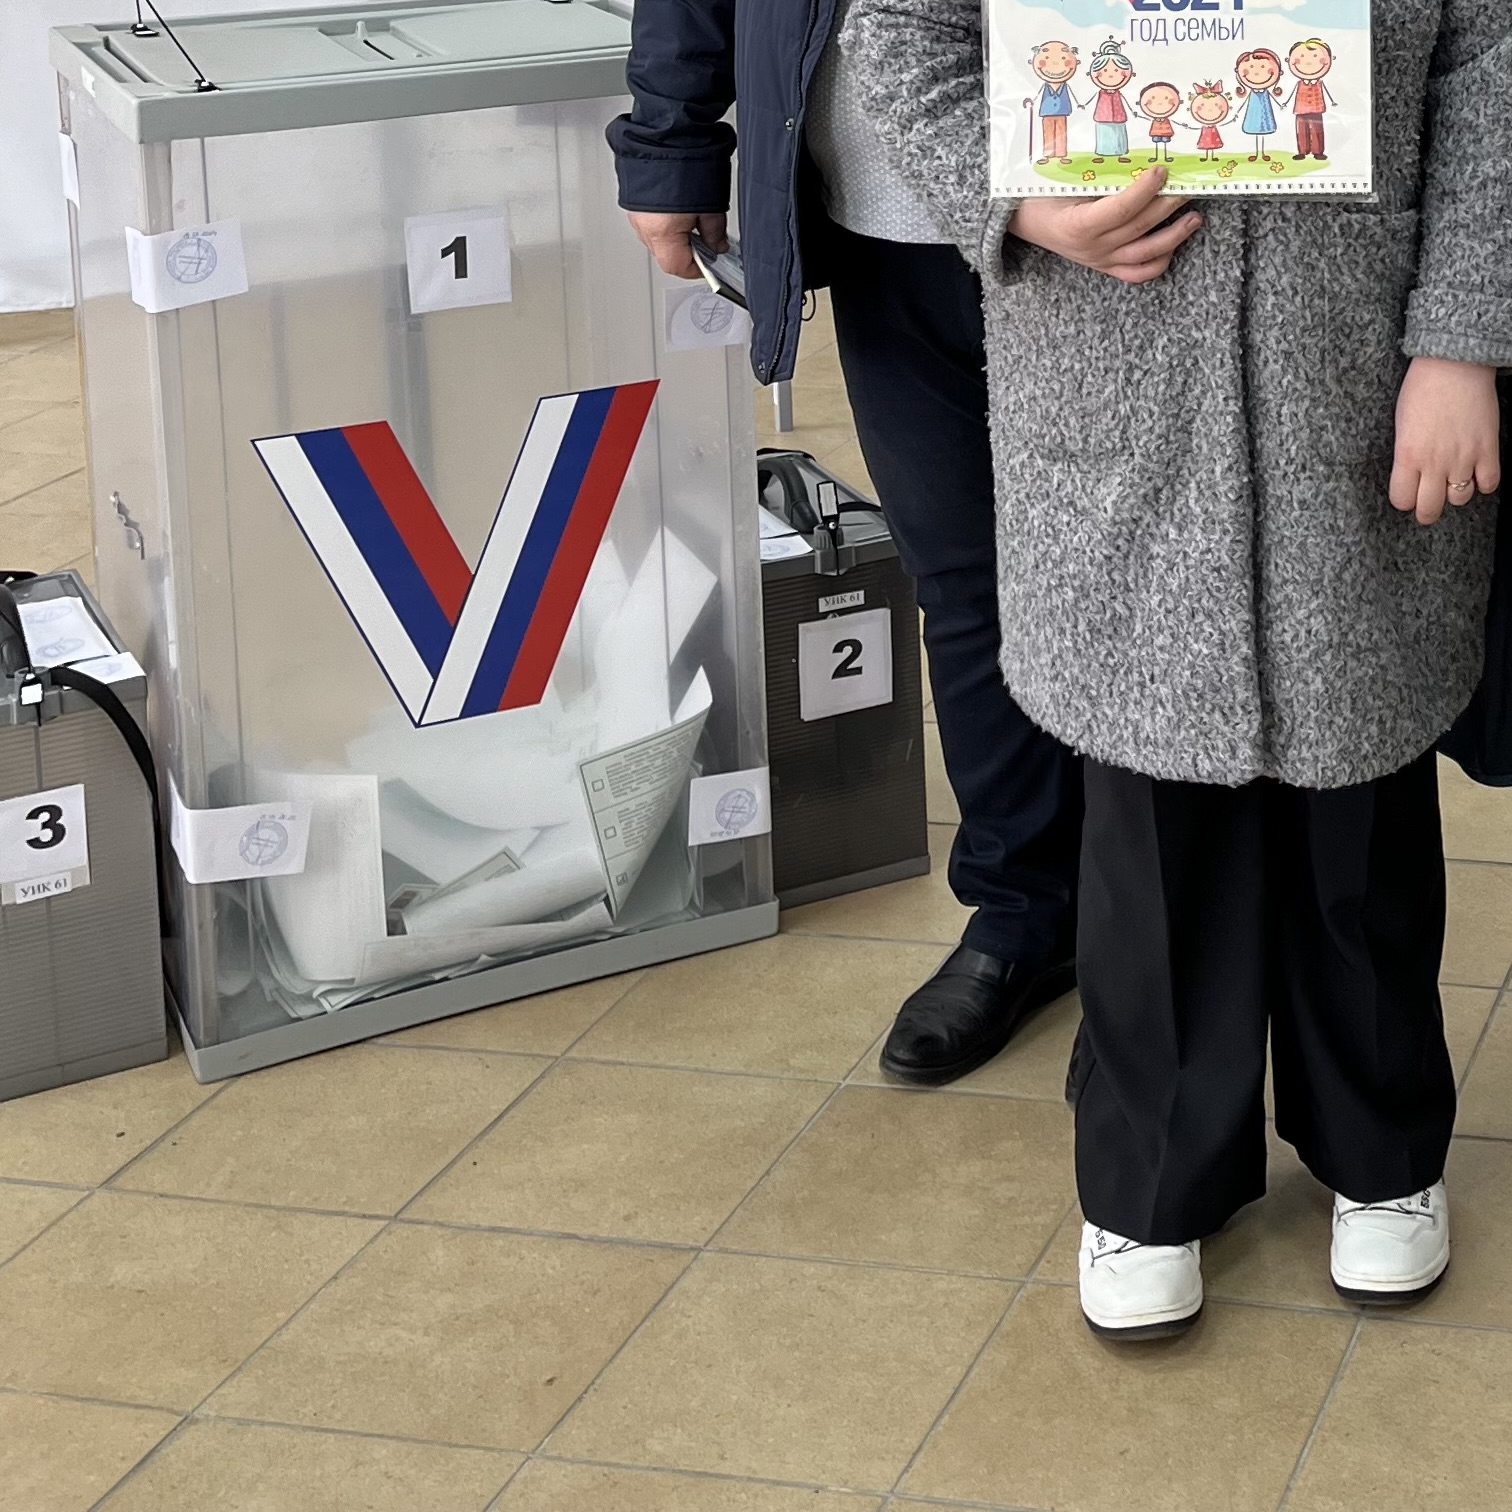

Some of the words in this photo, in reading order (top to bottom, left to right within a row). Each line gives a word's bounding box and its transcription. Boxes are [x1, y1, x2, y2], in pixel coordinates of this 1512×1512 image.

[441, 235, 468, 279] 1
[824, 595, 849, 607] УИК
[850, 593, 860, 602] 61
[831, 638, 863, 680] 2
[25, 804, 66, 850] 3
[20, 881, 51, 898] УИК
[54, 877, 68, 889] 61
